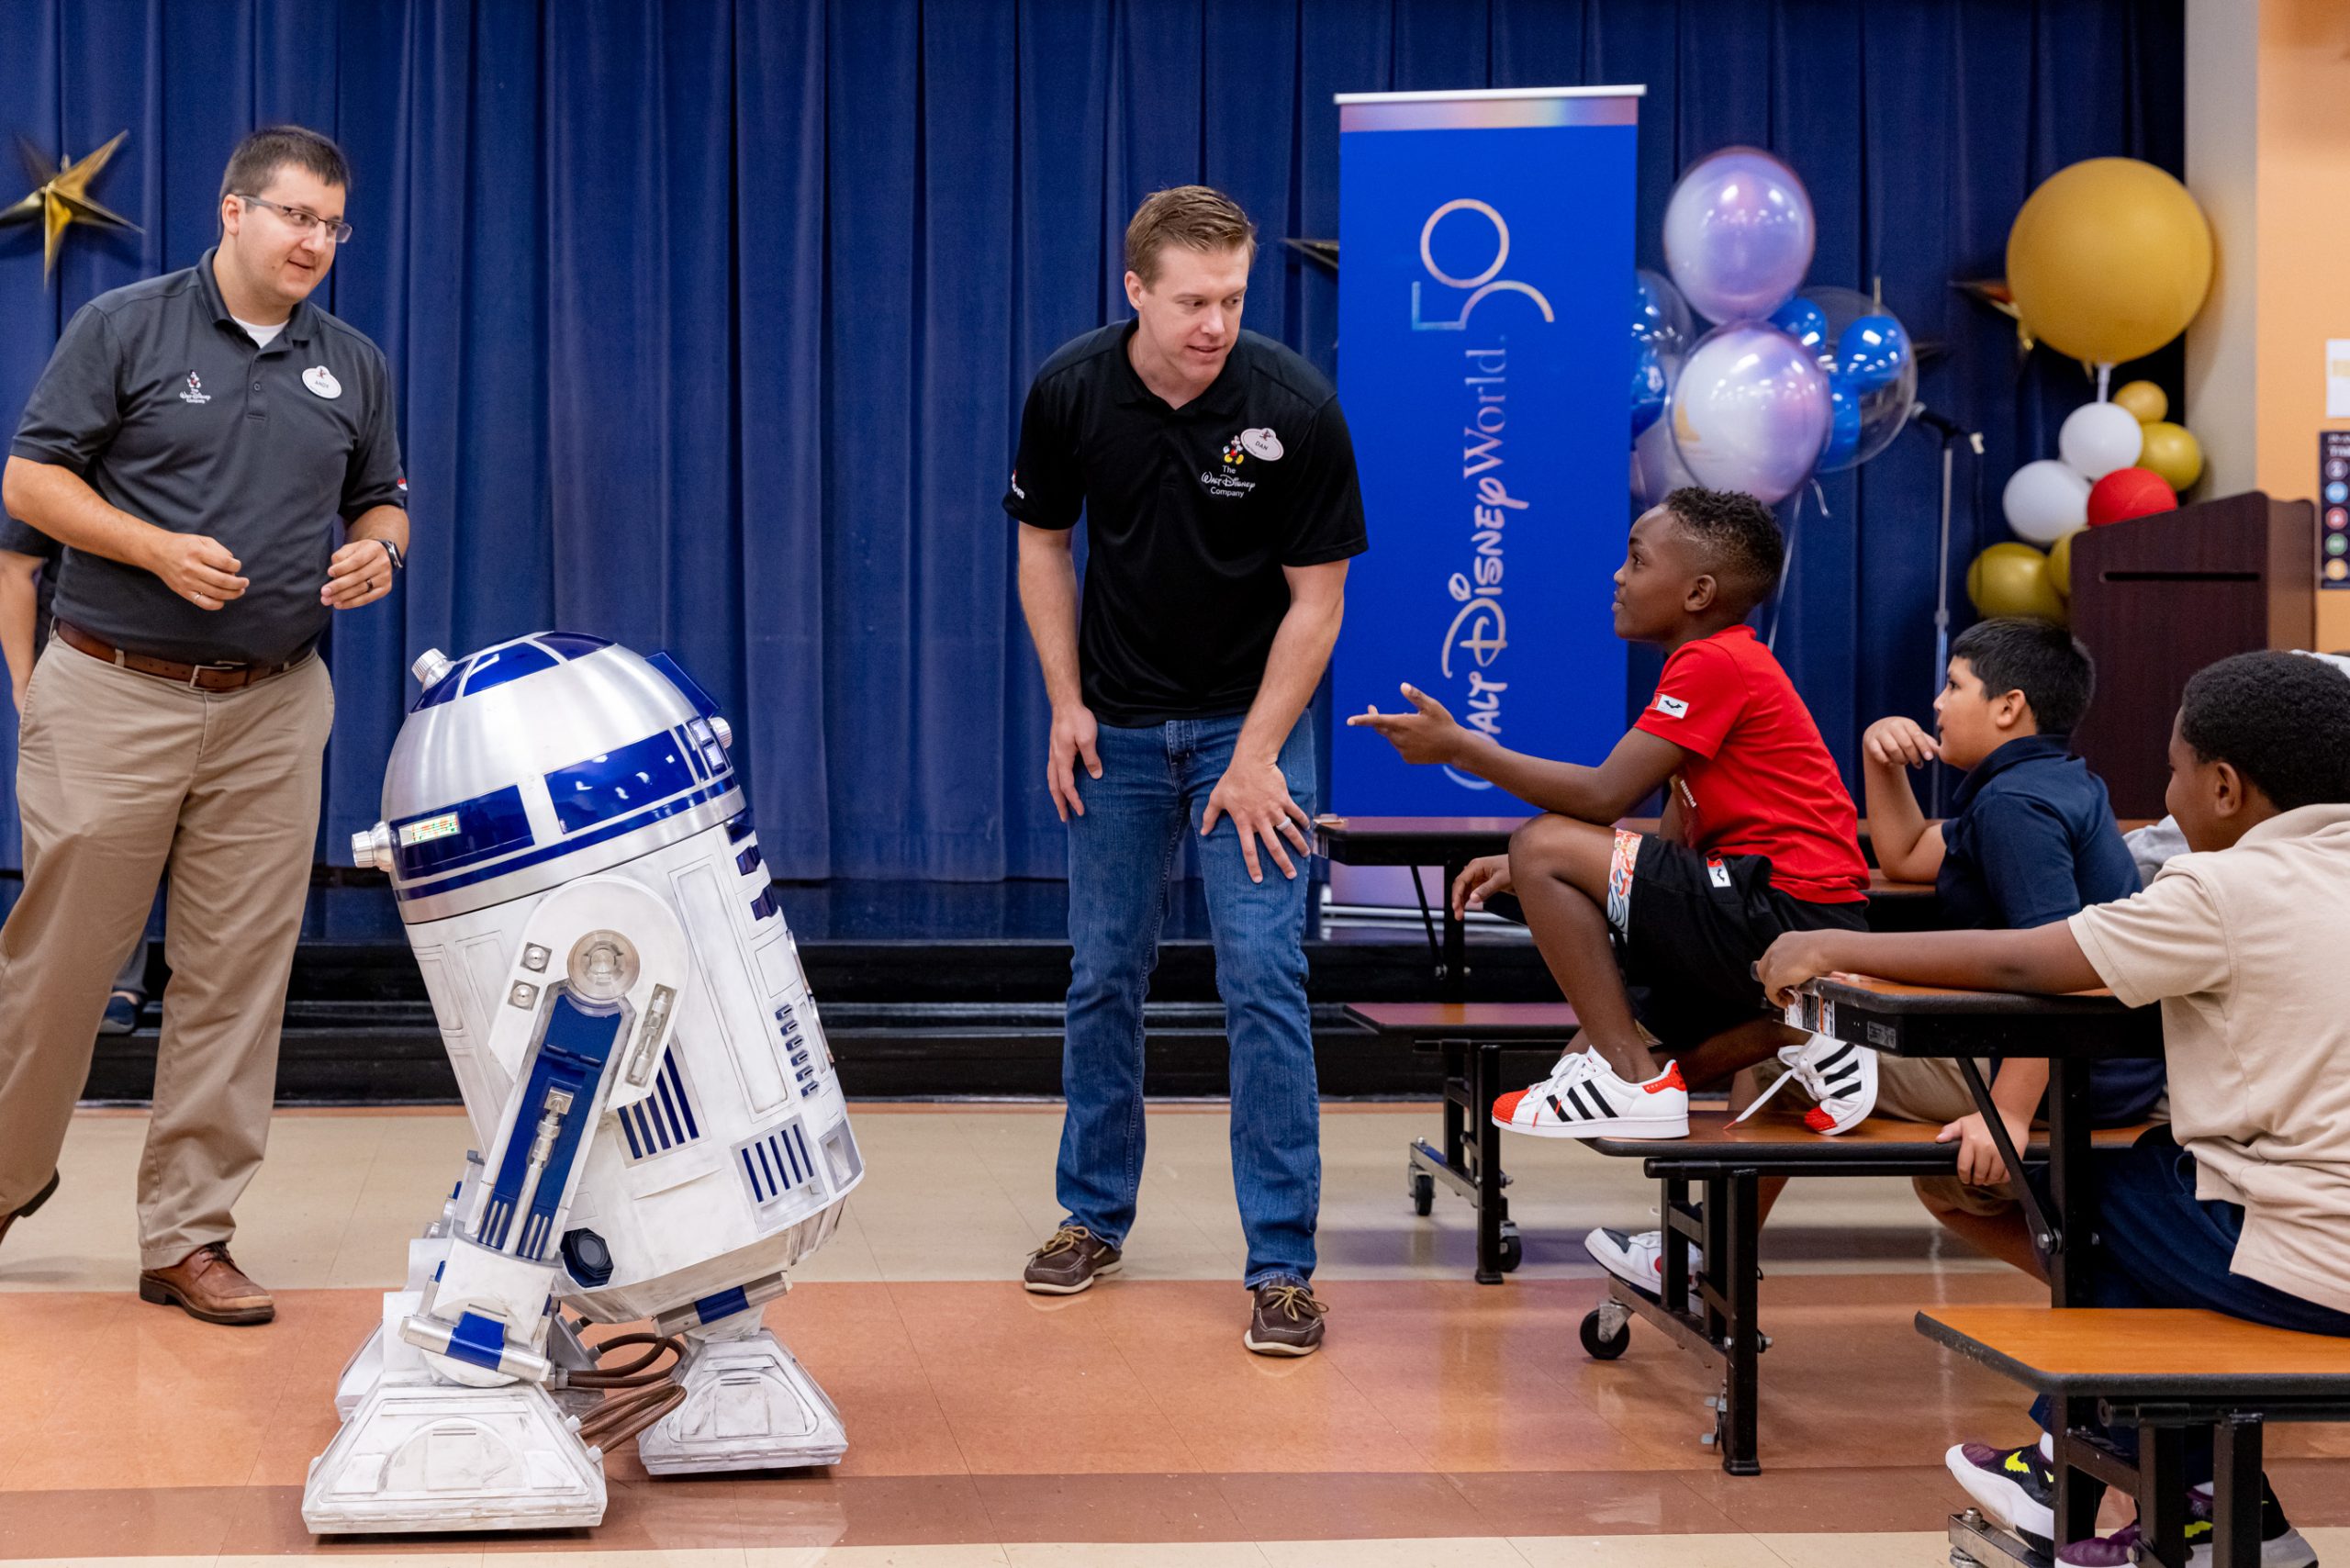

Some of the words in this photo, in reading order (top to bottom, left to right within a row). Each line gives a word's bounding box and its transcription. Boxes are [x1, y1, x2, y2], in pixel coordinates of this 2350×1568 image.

[1412, 198, 1555, 331] 50
[1255, 441, 1269, 451] DAN
[1222, 465, 1237, 475] The
[1210, 487, 1245, 498] Company
